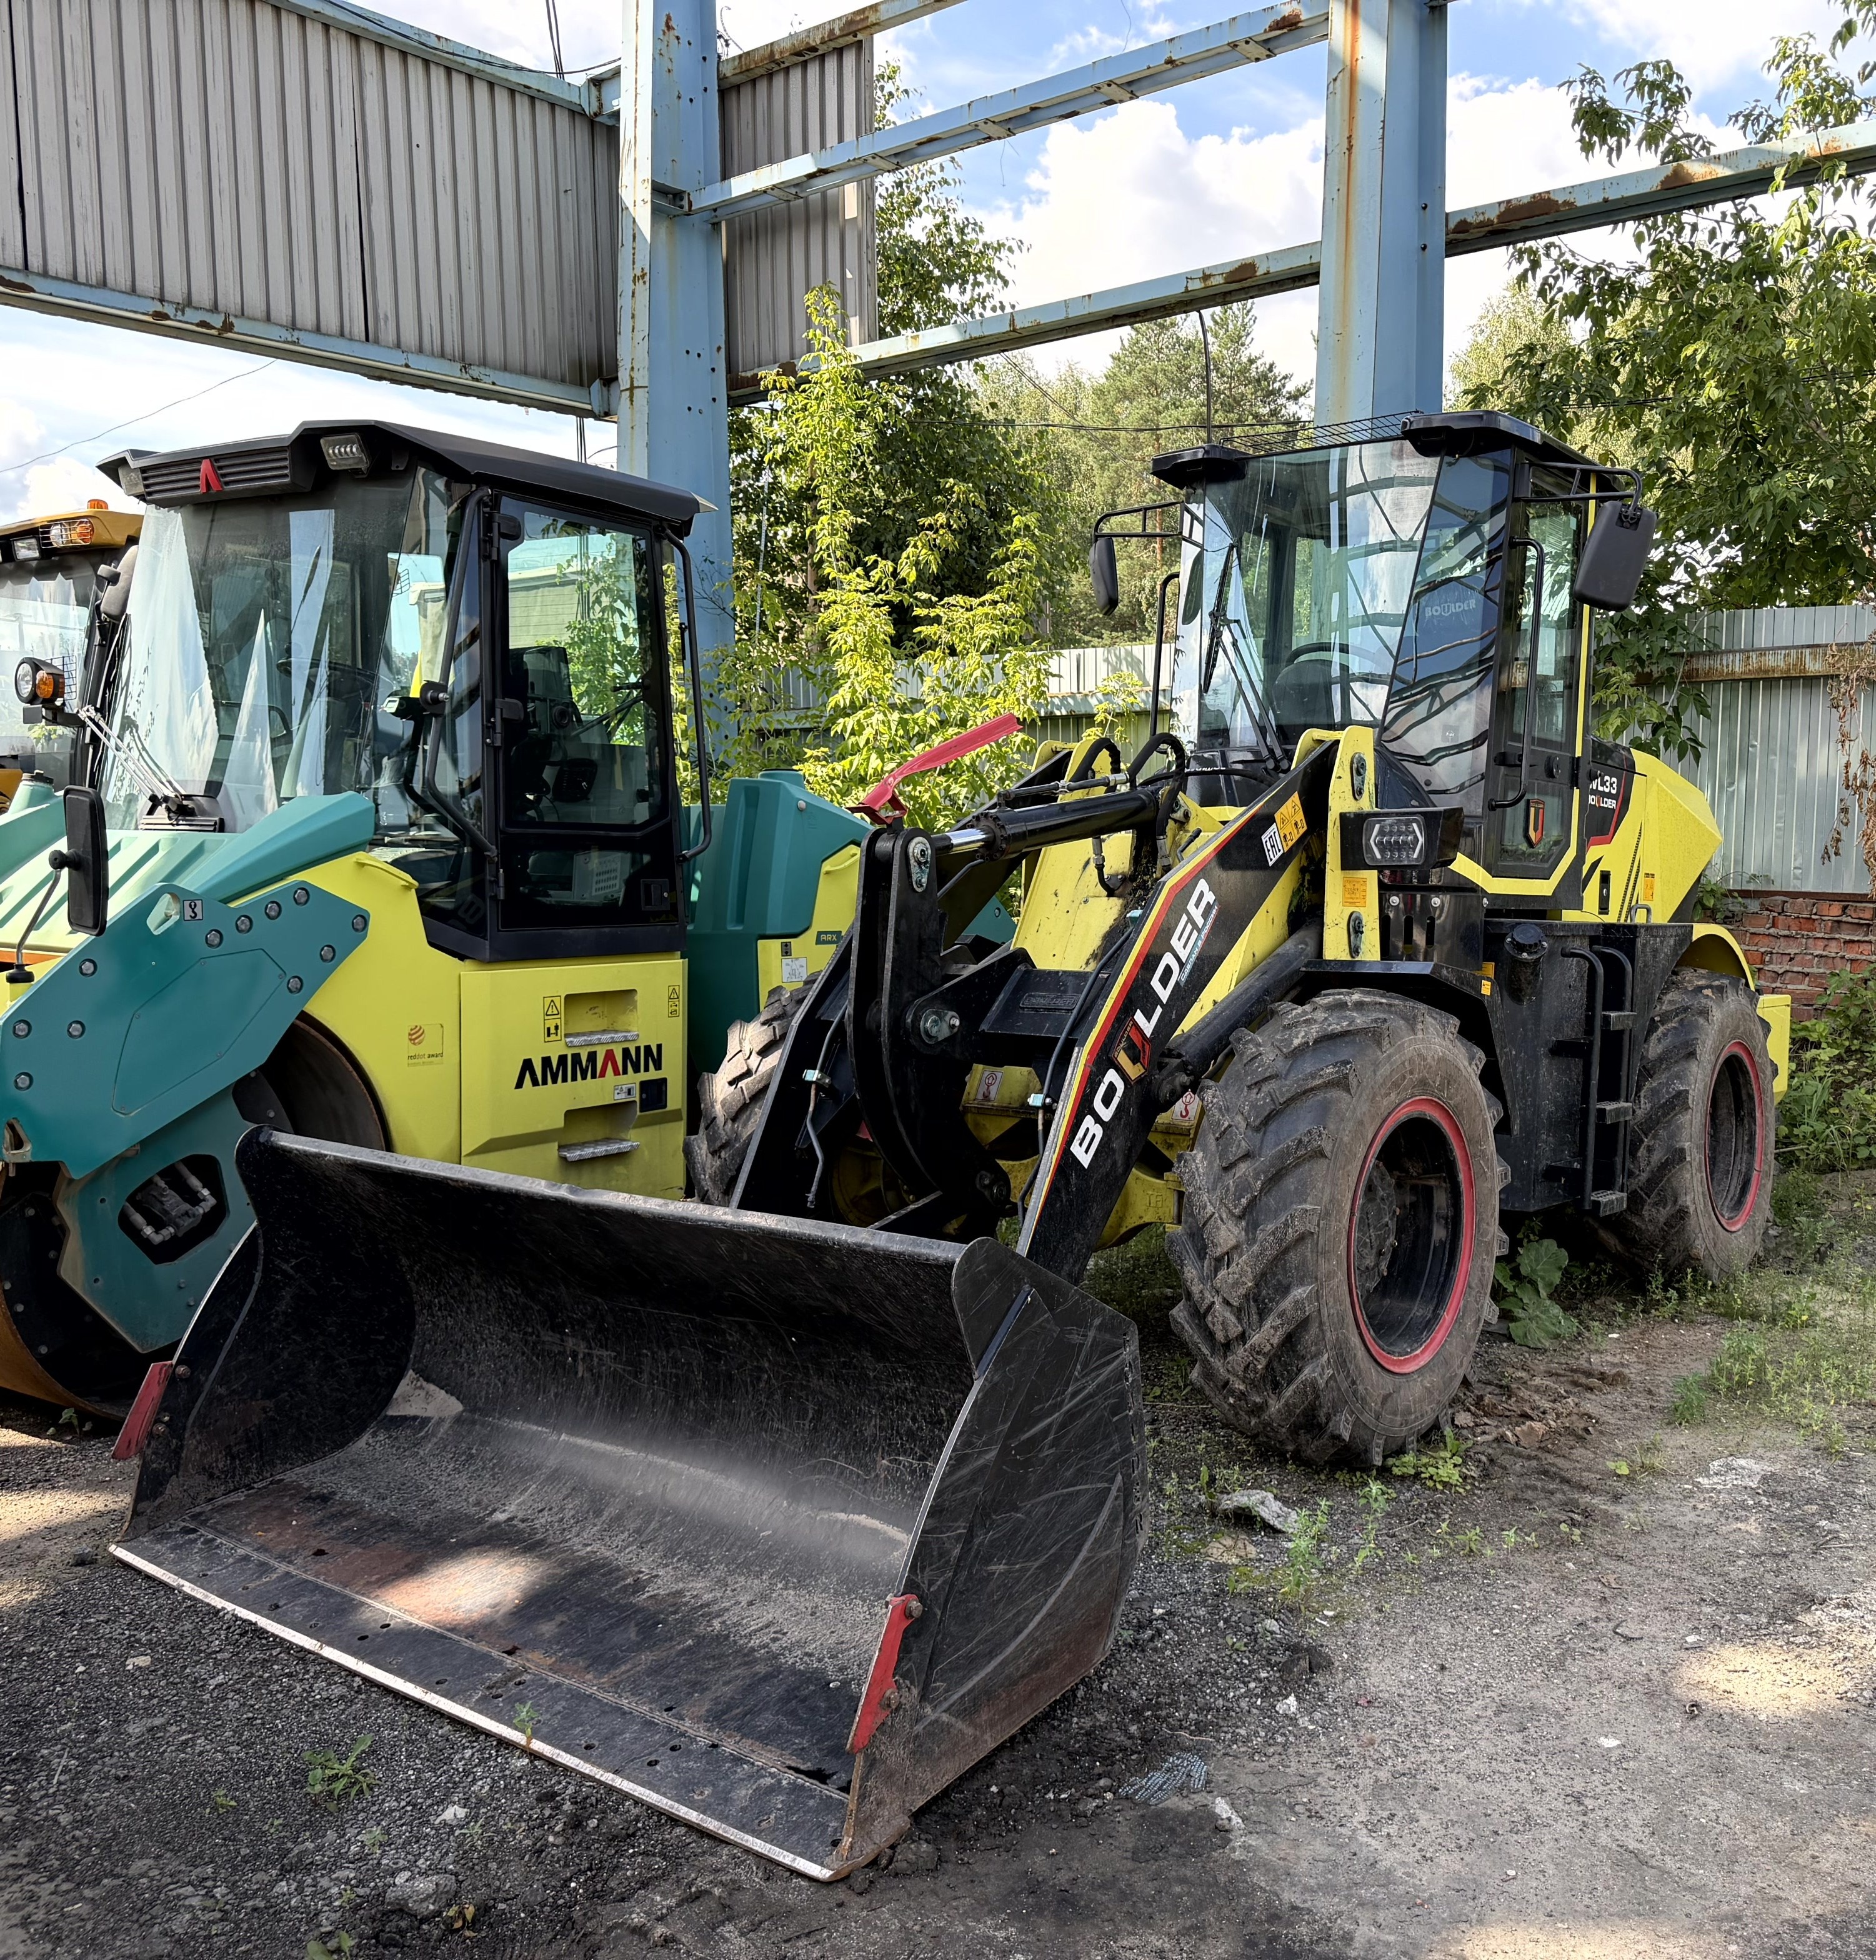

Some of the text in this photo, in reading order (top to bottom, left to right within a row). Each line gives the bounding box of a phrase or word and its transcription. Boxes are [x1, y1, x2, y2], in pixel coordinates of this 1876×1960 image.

[1425, 599, 1475, 616] BOULDER
[1589, 794, 1617, 809] OULDER
[1200, 905, 1218, 939] РОССИИ
[821, 934, 837, 942] ARX
[1070, 878, 1216, 1169] BOULDER
[514, 1043, 662, 1089] AMMANN
